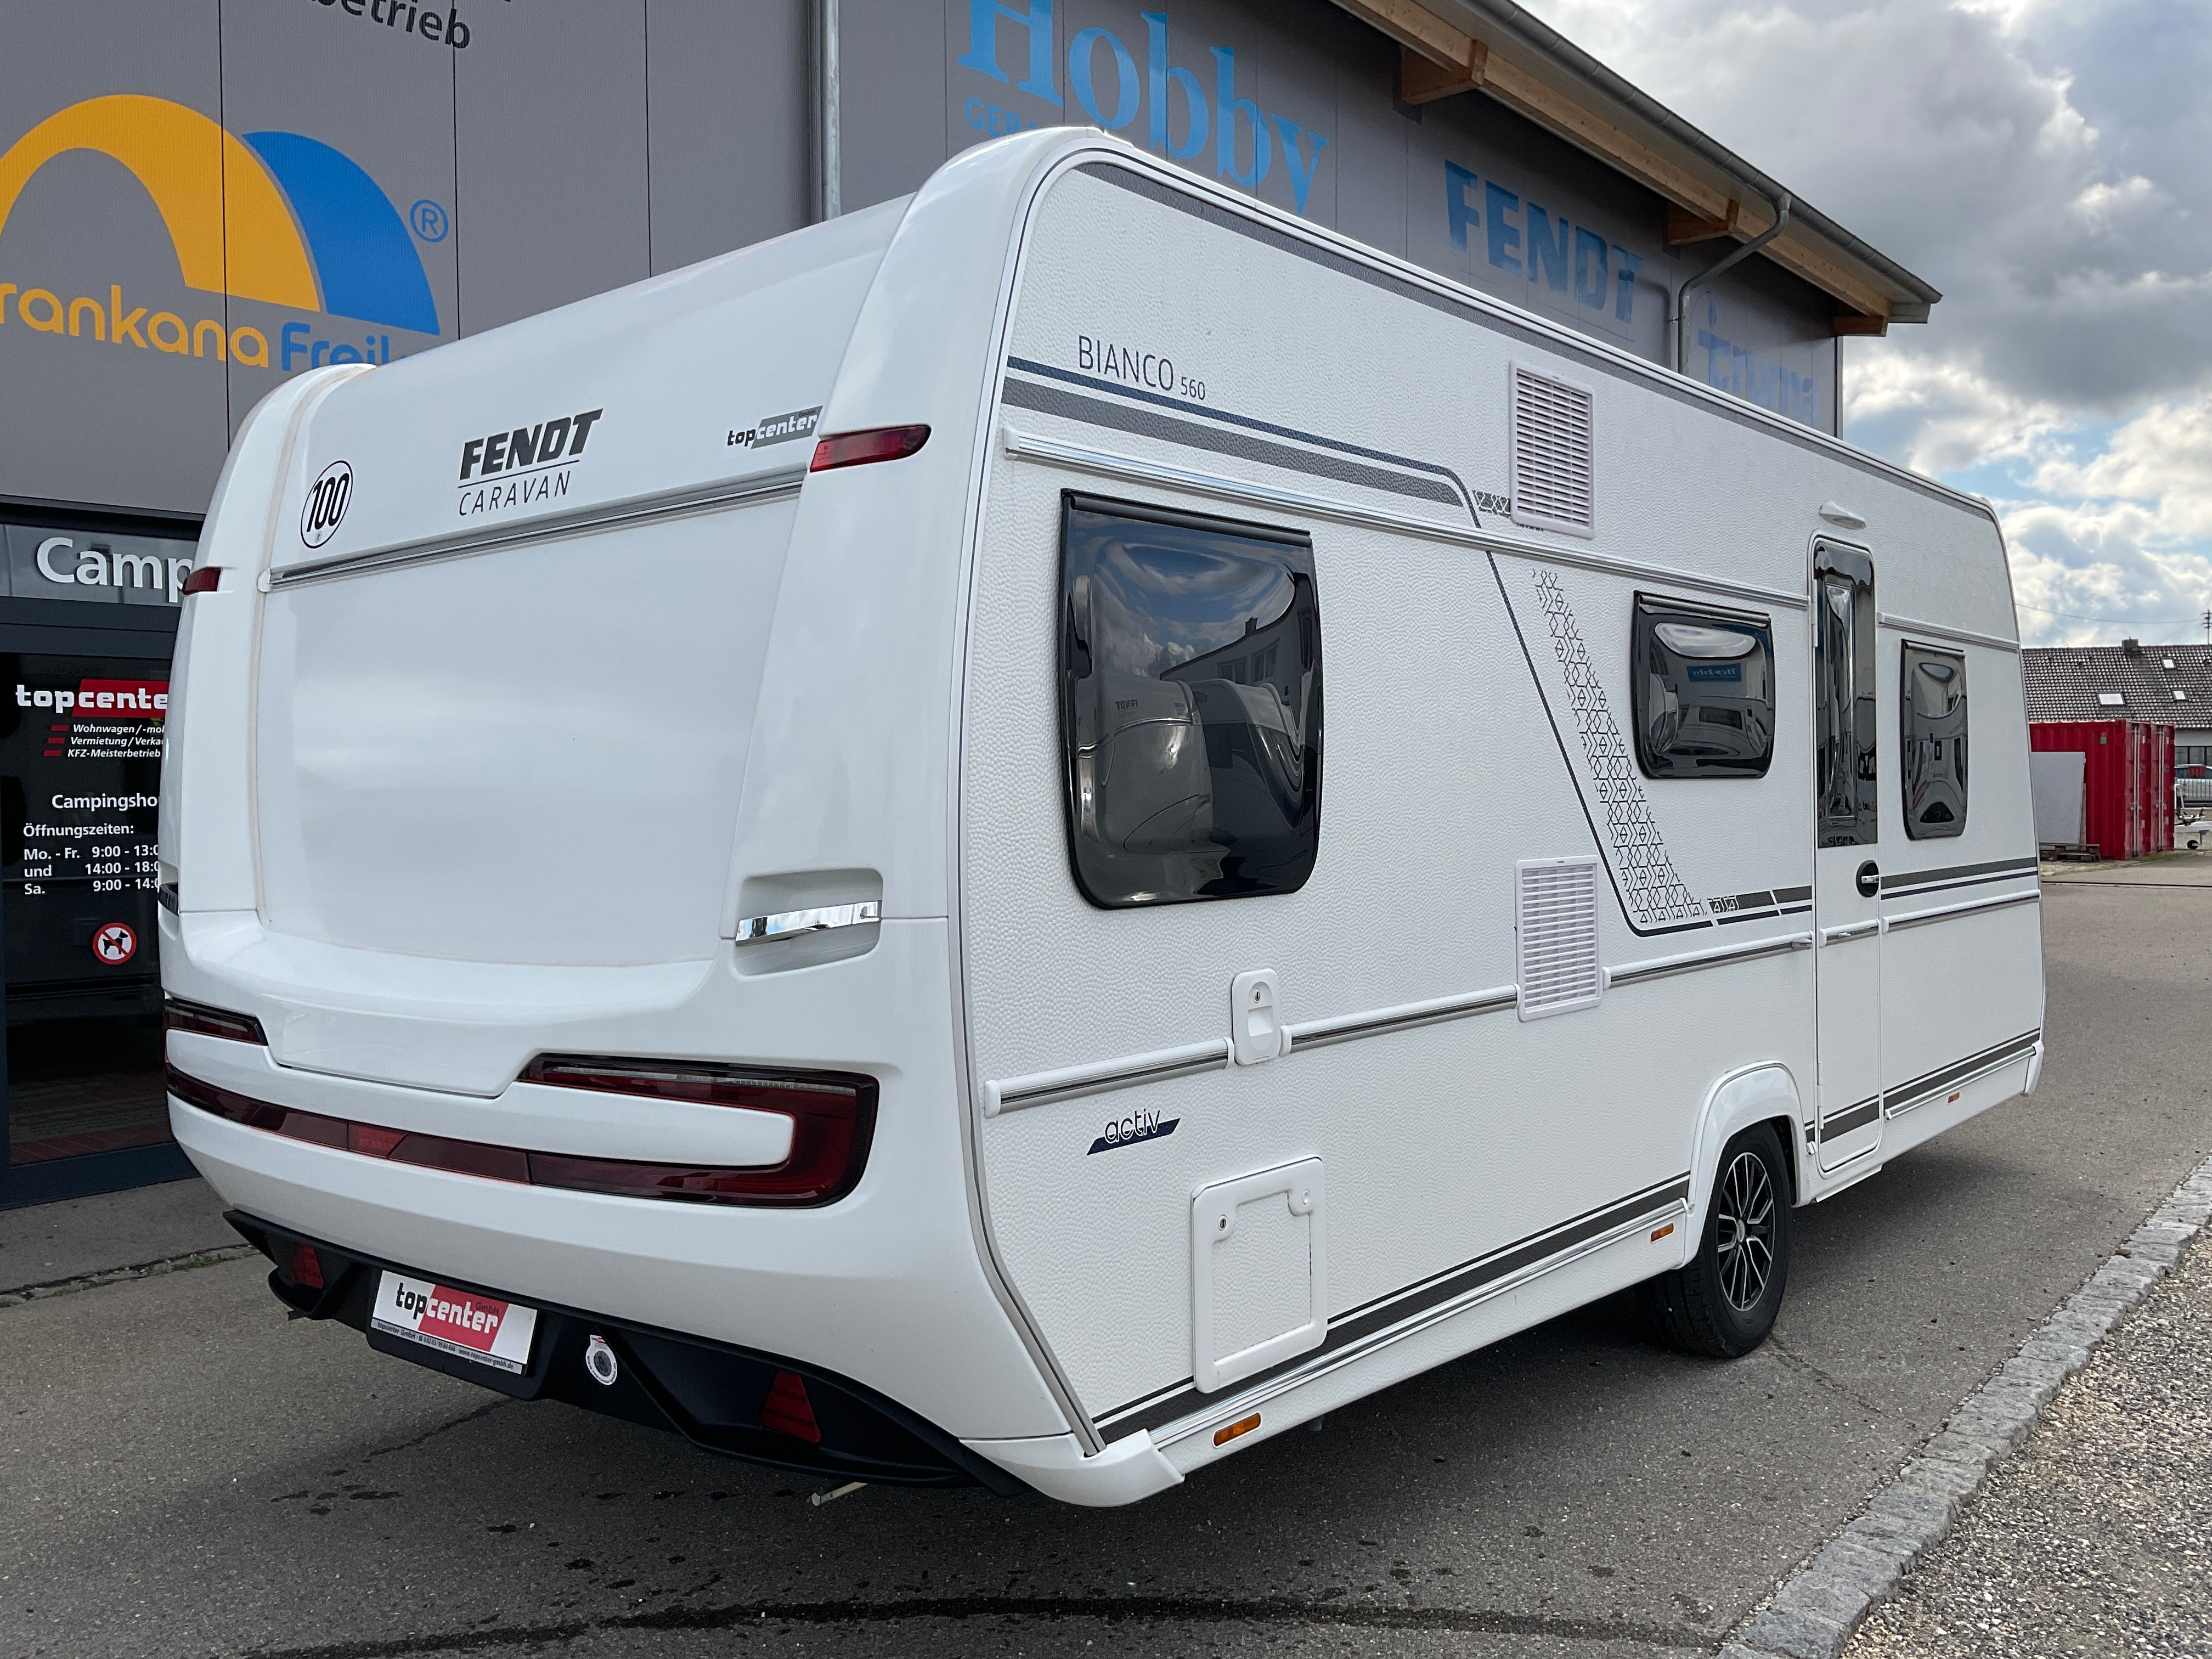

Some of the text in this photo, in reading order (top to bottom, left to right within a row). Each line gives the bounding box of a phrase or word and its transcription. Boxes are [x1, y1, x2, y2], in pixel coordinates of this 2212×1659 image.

[958, 0, 1330, 217] Hobby
[1444, 159, 1645, 324] FENDT
[1079, 335, 1206, 400] BIANCO 560
[727, 414, 819, 447] topcenter
[459, 408, 603, 481] FENDT
[306, 473, 349, 533] 100
[459, 470, 571, 516] CARAVAN
[70, 736, 127, 747] Vermietung
[135, 737, 163, 745] Verka
[73, 724, 135, 735] Wohnwagen
[67, 749, 161, 758] KFZ-Meisterbetrieb
[23, 823, 134, 838] Öffnungszeiten:
[24, 849, 52, 860] Mo.
[64, 848, 80, 859] Fr.
[92, 846, 121, 857] 9:00
[24, 865, 52, 877] und
[85, 862, 121, 874] 14:00
[24, 883, 46, 895] Sa.
[93, 879, 122, 891] 9:00
[1105, 1108, 1160, 1144] activ
[396, 1282, 499, 1334] topcenter
[475, 1301, 500, 1314] GmbH
[377, 1322, 399, 1335] topcenter
[400, 1328, 416, 1340] GmbH
